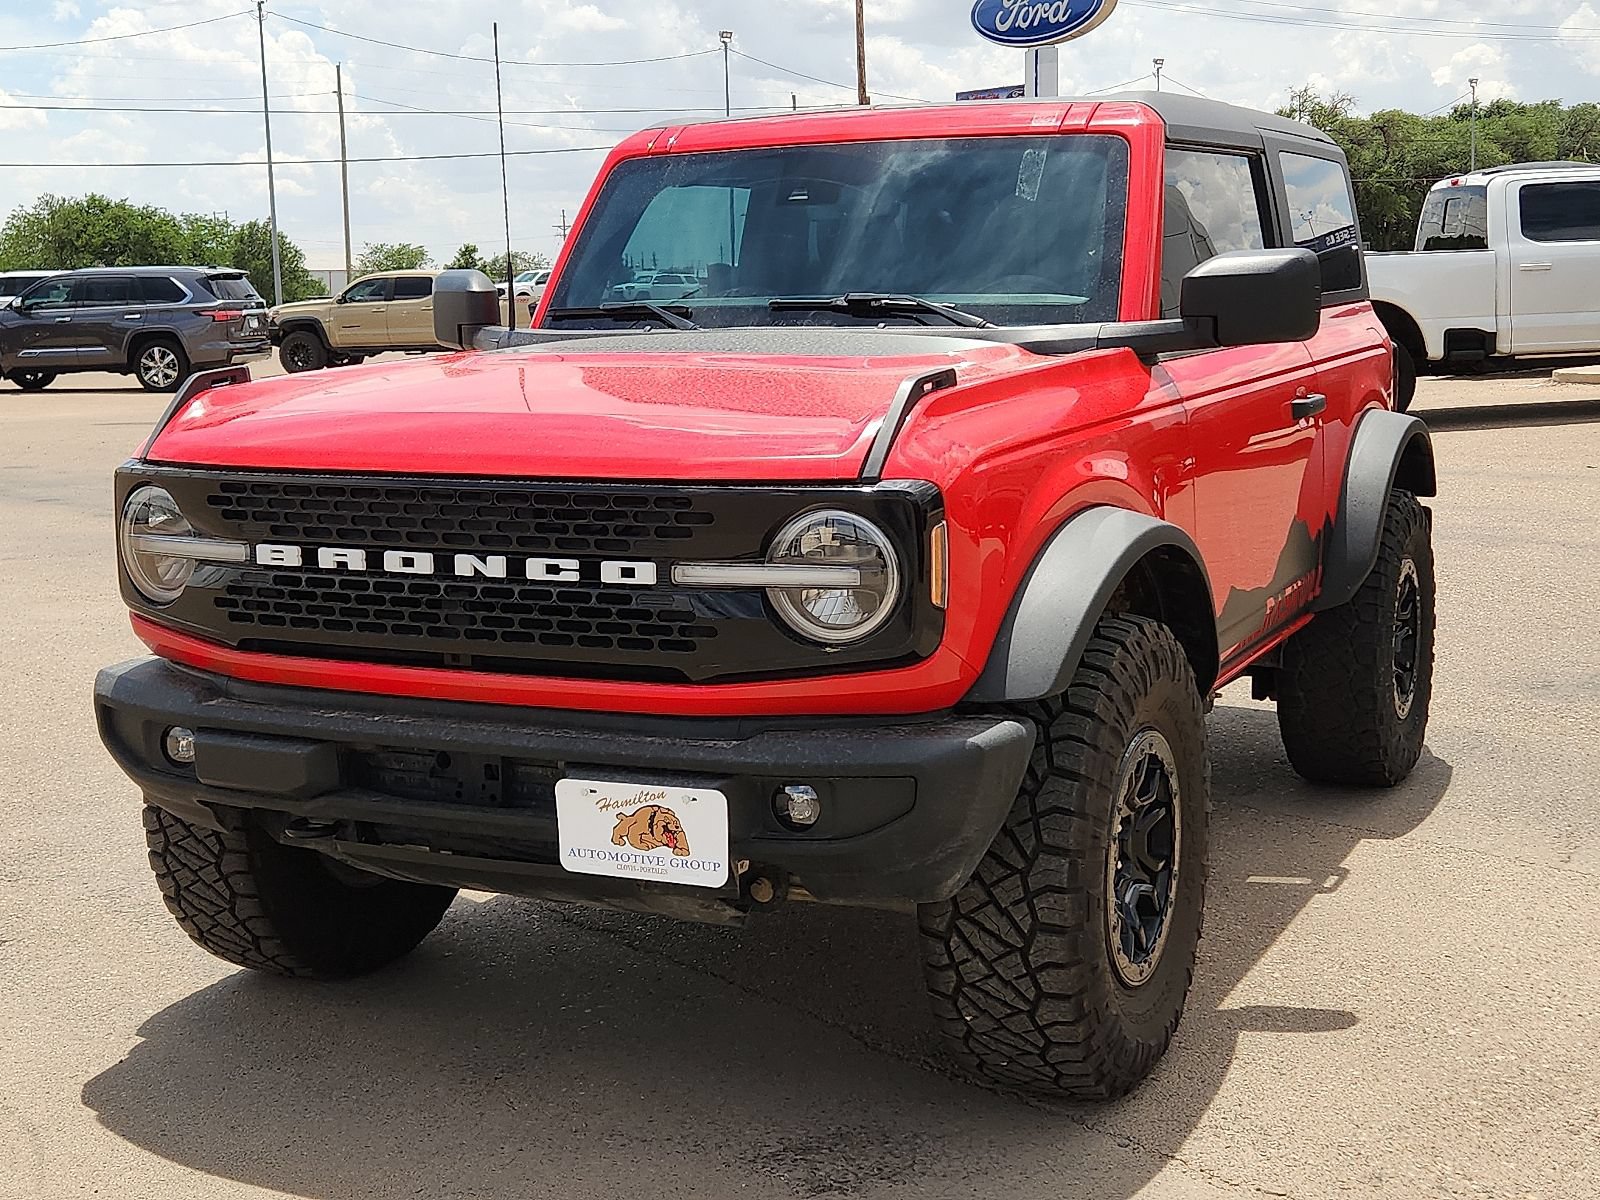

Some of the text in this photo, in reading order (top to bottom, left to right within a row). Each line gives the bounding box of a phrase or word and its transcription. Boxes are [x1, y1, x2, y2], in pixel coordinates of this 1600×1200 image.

[995, 0, 1072, 32] Ford
[255, 543, 657, 585] BRONCO
[595, 790, 667, 813] Hamilton
[567, 847, 721, 873] AUTOMOTIVE GROUP
